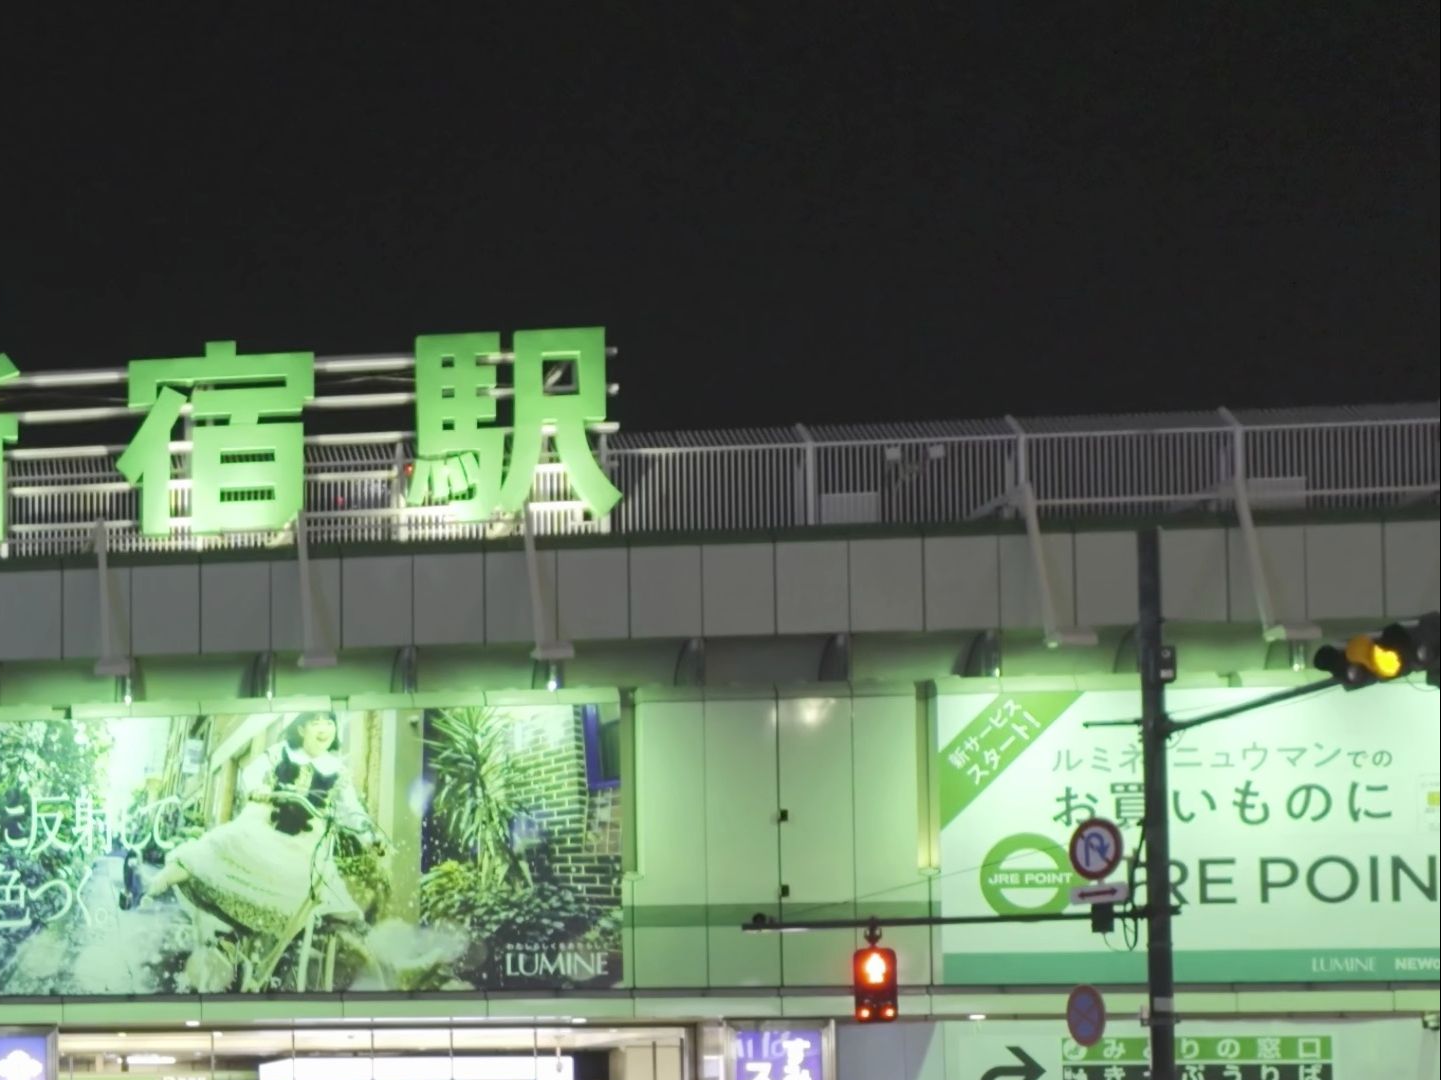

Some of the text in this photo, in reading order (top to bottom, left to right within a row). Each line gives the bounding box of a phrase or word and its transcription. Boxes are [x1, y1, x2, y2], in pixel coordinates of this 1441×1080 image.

[947, 698, 1023, 770] 新サービス
[1052, 741, 1393, 772] ルミネニュウマンでの
[988, 871, 1073, 885] JRE POINT
[505, 952, 609, 976] LUMINE
[1312, 957, 1376, 973] LUMINE
[1102, 1038, 1322, 1060] みりの窓口
